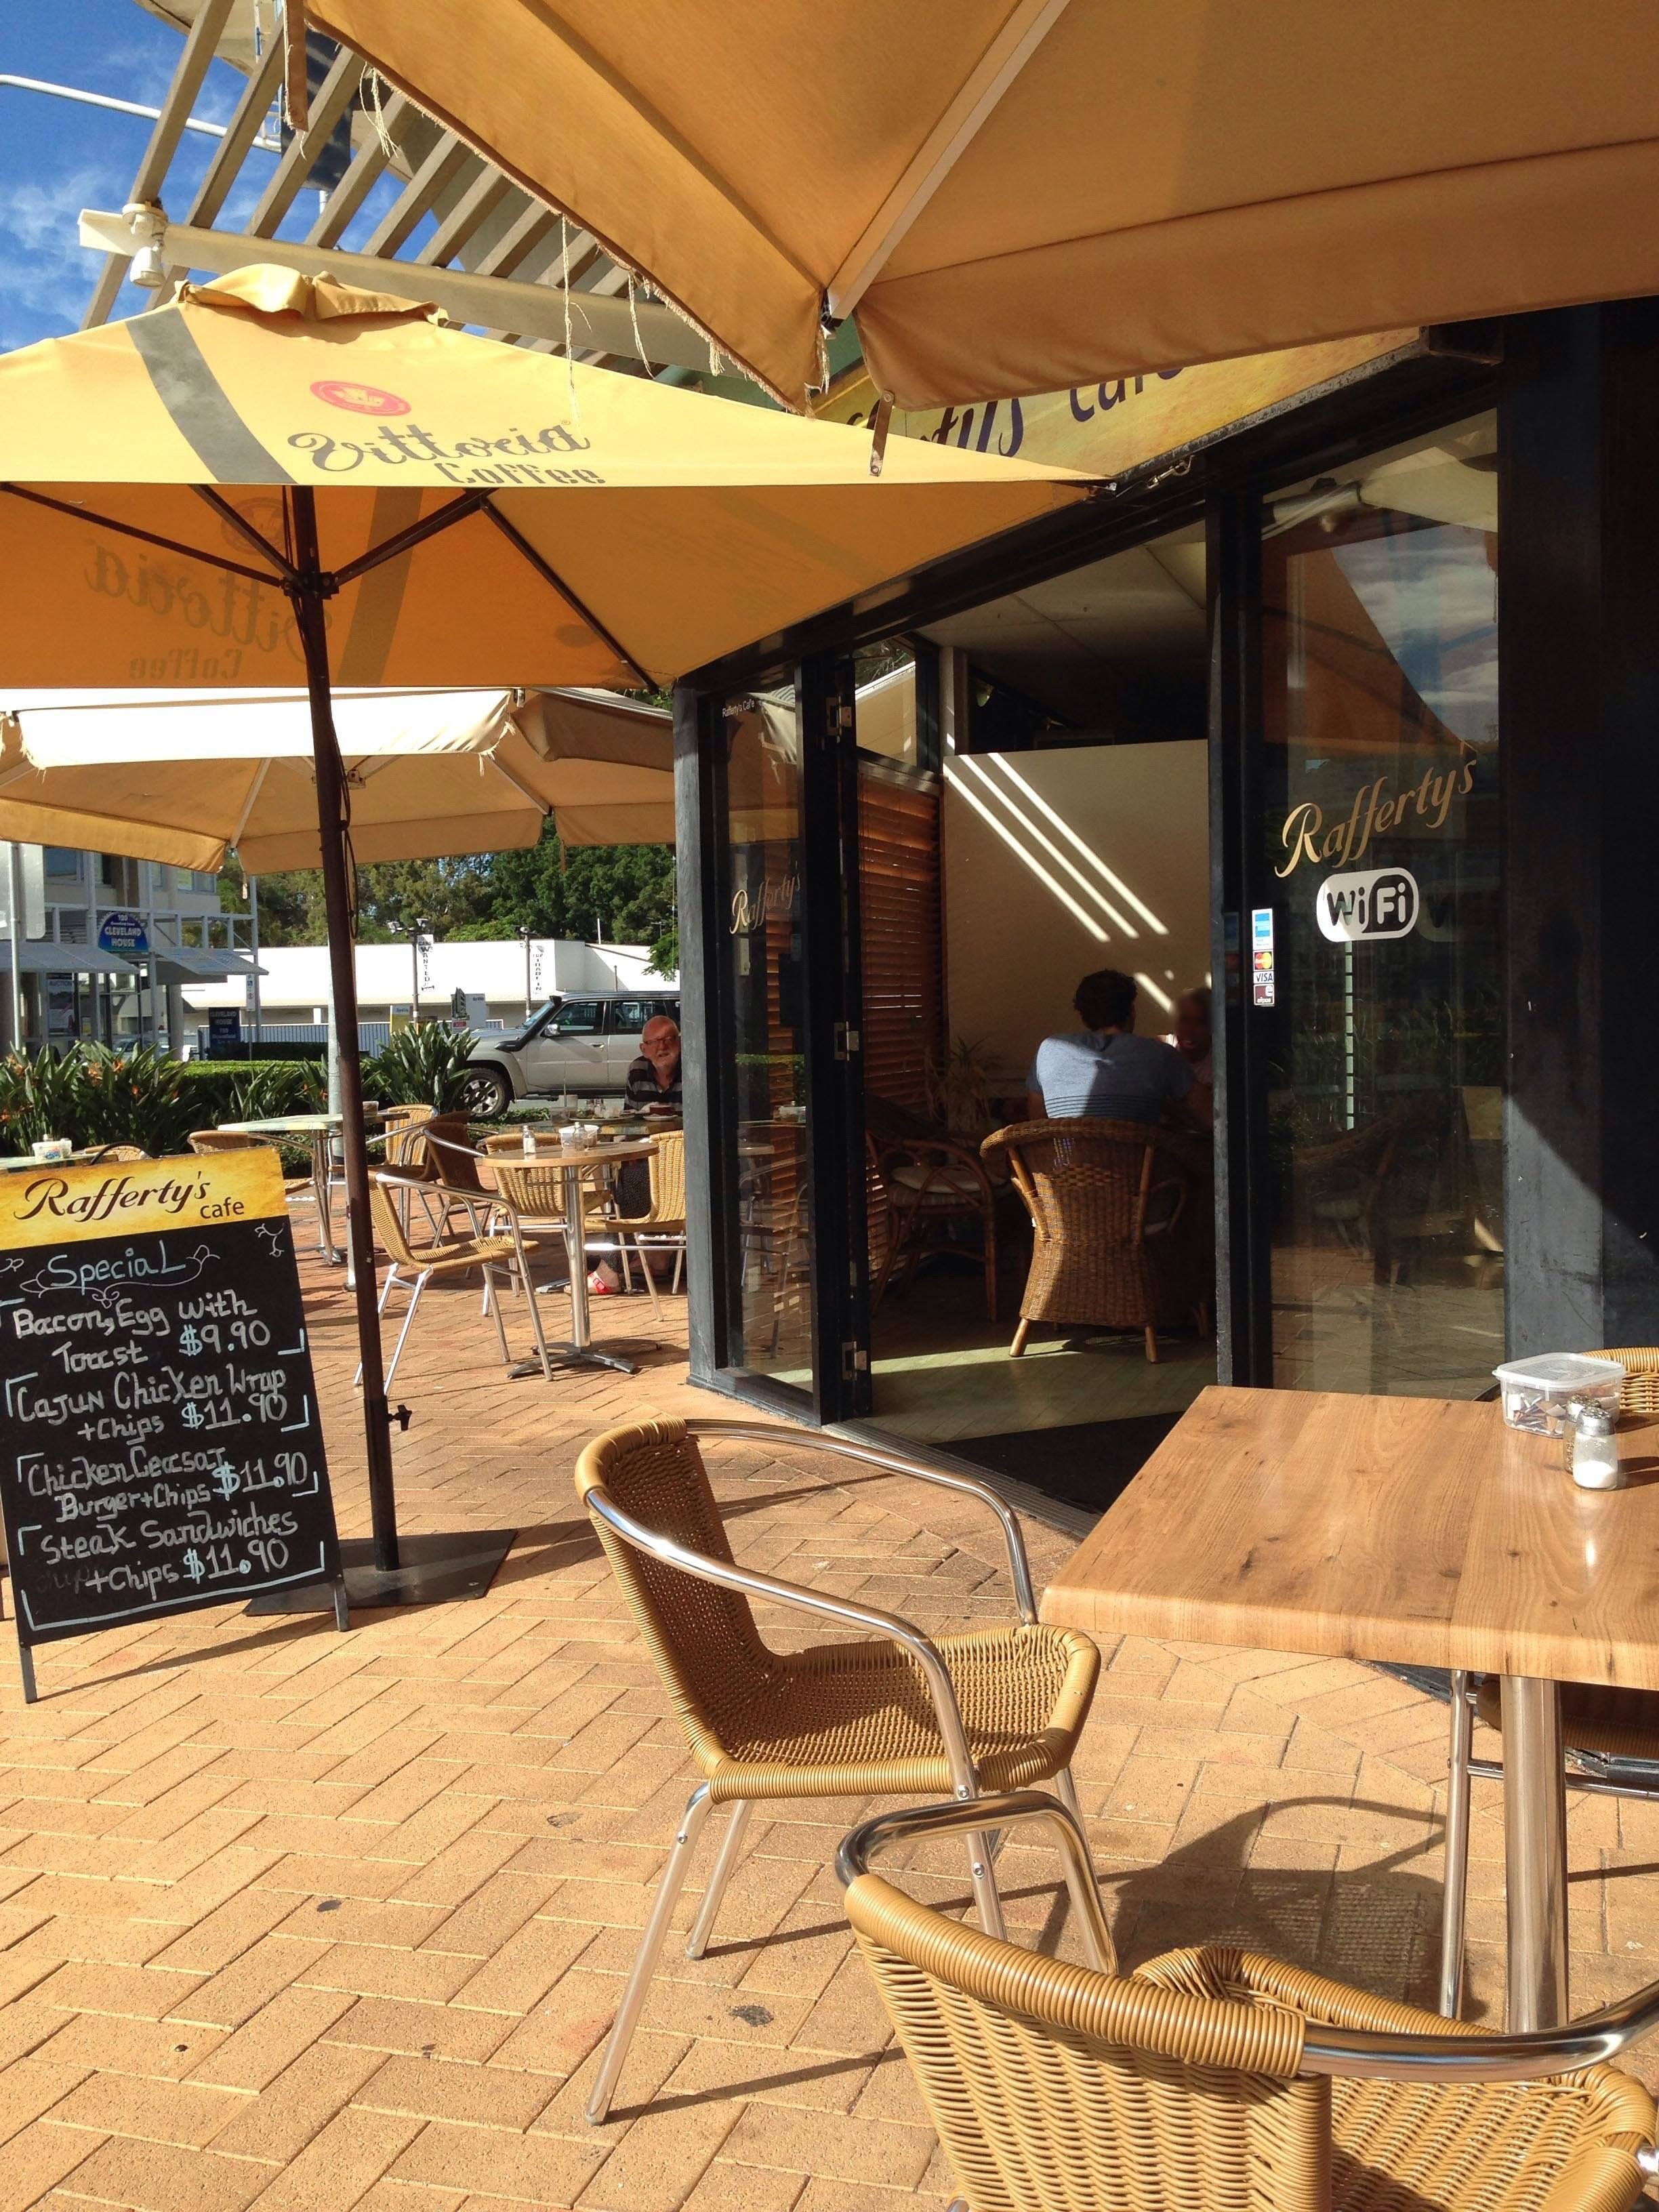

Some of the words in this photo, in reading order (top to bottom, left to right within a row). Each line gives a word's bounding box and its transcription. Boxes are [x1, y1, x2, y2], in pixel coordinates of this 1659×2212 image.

[287, 424, 591, 472] Vittoria
[433, 462, 607, 485] Coffee
[1326, 882, 1407, 926] WiFi
[104, 926, 142, 936] CLEVELAND
[110, 939, 136, 947] HOUSE
[1256, 972, 1273, 982] VISA
[14, 1171, 211, 1223] Rafferty's
[200, 1197, 245, 1219] cafe
[52, 1340, 148, 1374] Toast
[180, 1320, 270, 1356] $9.90
[226, 1363, 287, 1404] Wrap
[181, 1393, 288, 1429] $11.90
[28, 1456, 135, 1496] Chicken
[211, 1452, 308, 1501] $11.90
[140, 1502, 298, 1549] Sandwiches
[183, 1538, 289, 1584] $11.90
